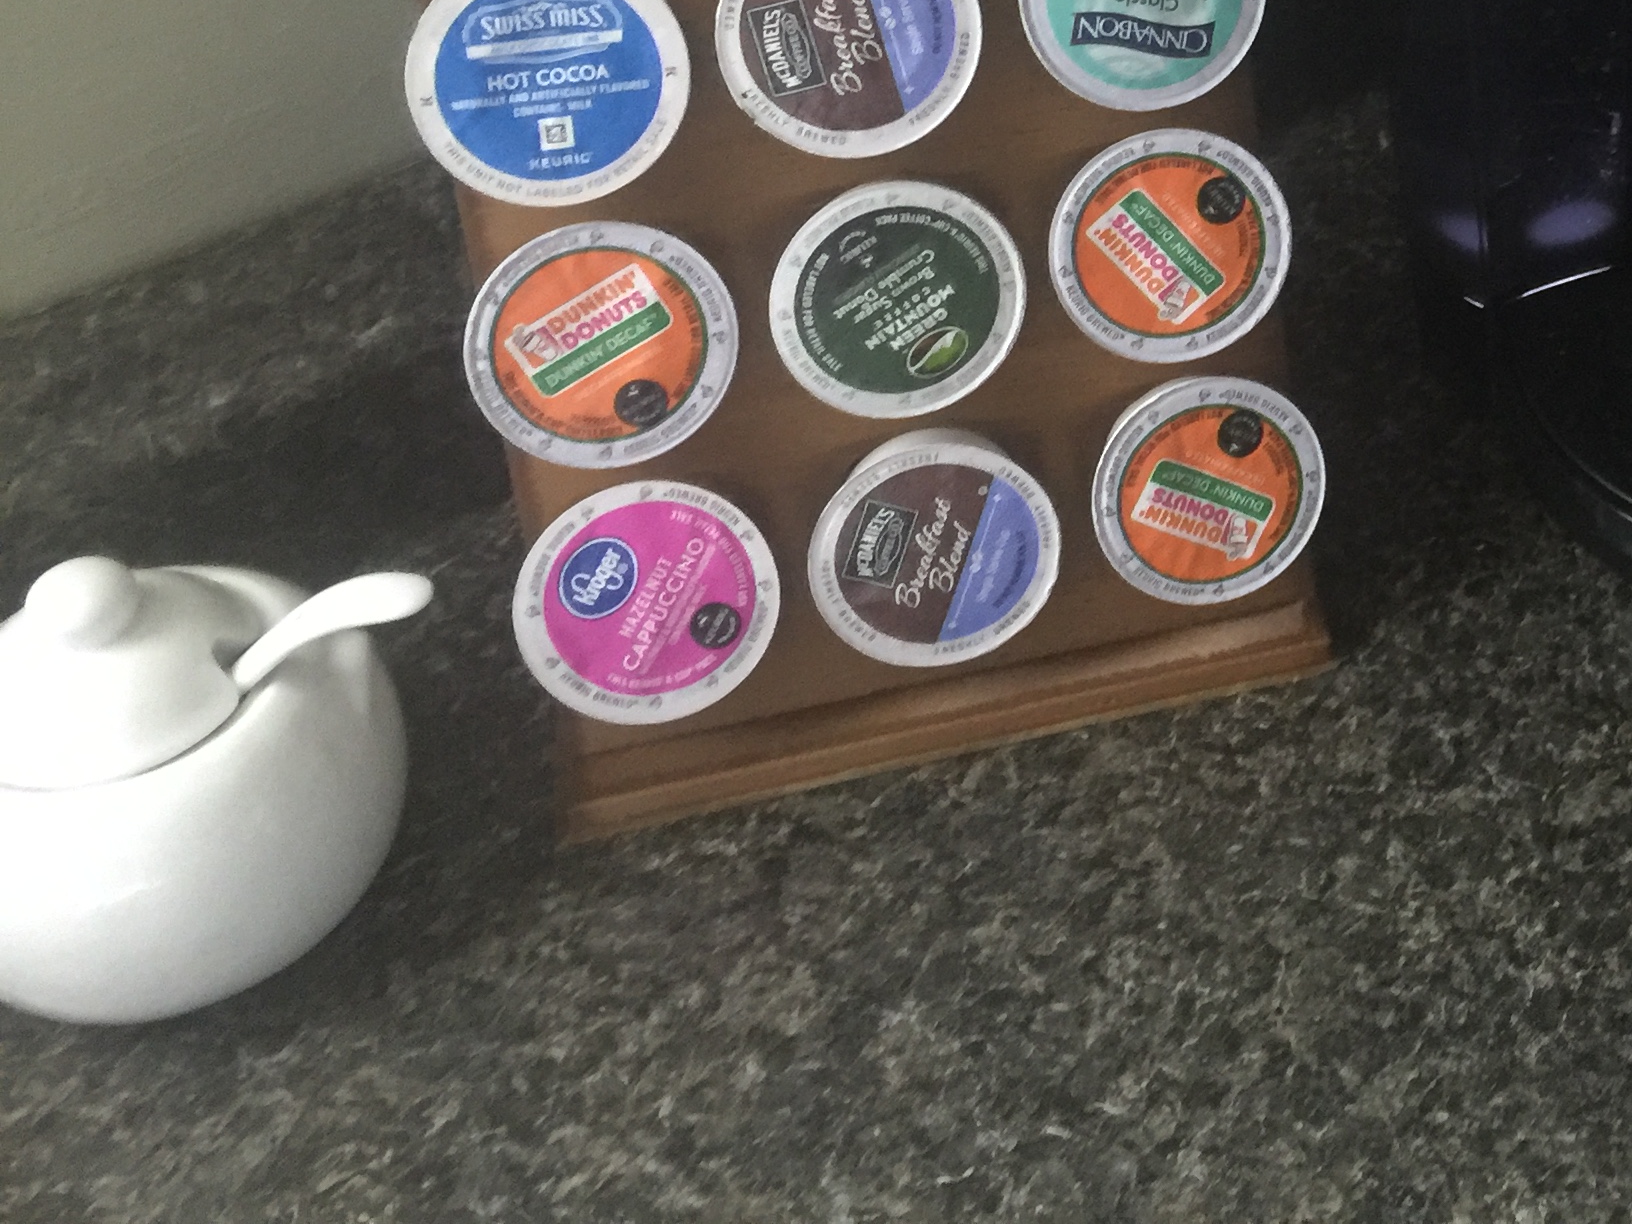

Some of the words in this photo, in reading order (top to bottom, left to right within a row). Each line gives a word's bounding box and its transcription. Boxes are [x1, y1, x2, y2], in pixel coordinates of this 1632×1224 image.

[480, 9, 544, 40] SWISS
[550, 5, 604, 27] MISS
[1078, 16, 1207, 53] CINNABON
[487, 72, 530, 92] HOT
[536, 64, 610, 86] COCOA
[528, 152, 591, 170] KEURIG
[1135, 204, 1174, 241] DECAF
[1093, 228, 1166, 295] DUNKIN'
[1111, 213, 1180, 282] DONUTS
[1171, 240, 1216, 286] DUNKIN'
[878, 249, 935, 290] Crumble
[891, 266, 935, 297] Brown
[547, 270, 637, 333] DUNKIN'
[561, 290, 647, 350] DONUTS
[833, 287, 879, 319] Donut
[854, 295, 893, 324] Sugar
[864, 284, 956, 351] MOUNTAIN
[607, 316, 652, 352] DECAF
[890, 308, 948, 351] GREEN
[1152, 488, 1229, 523] DONUTS
[1210, 484, 1264, 512] DUNKIN'
[1139, 506, 1222, 545] DUNKIN'
[895, 496, 951, 608] Breakfast
[928, 520, 971, 593] Blend
[571, 547, 624, 606] Kroger
[619, 556, 673, 638] HAZELNUT
[623, 537, 705, 671] CAPPUCCINO
